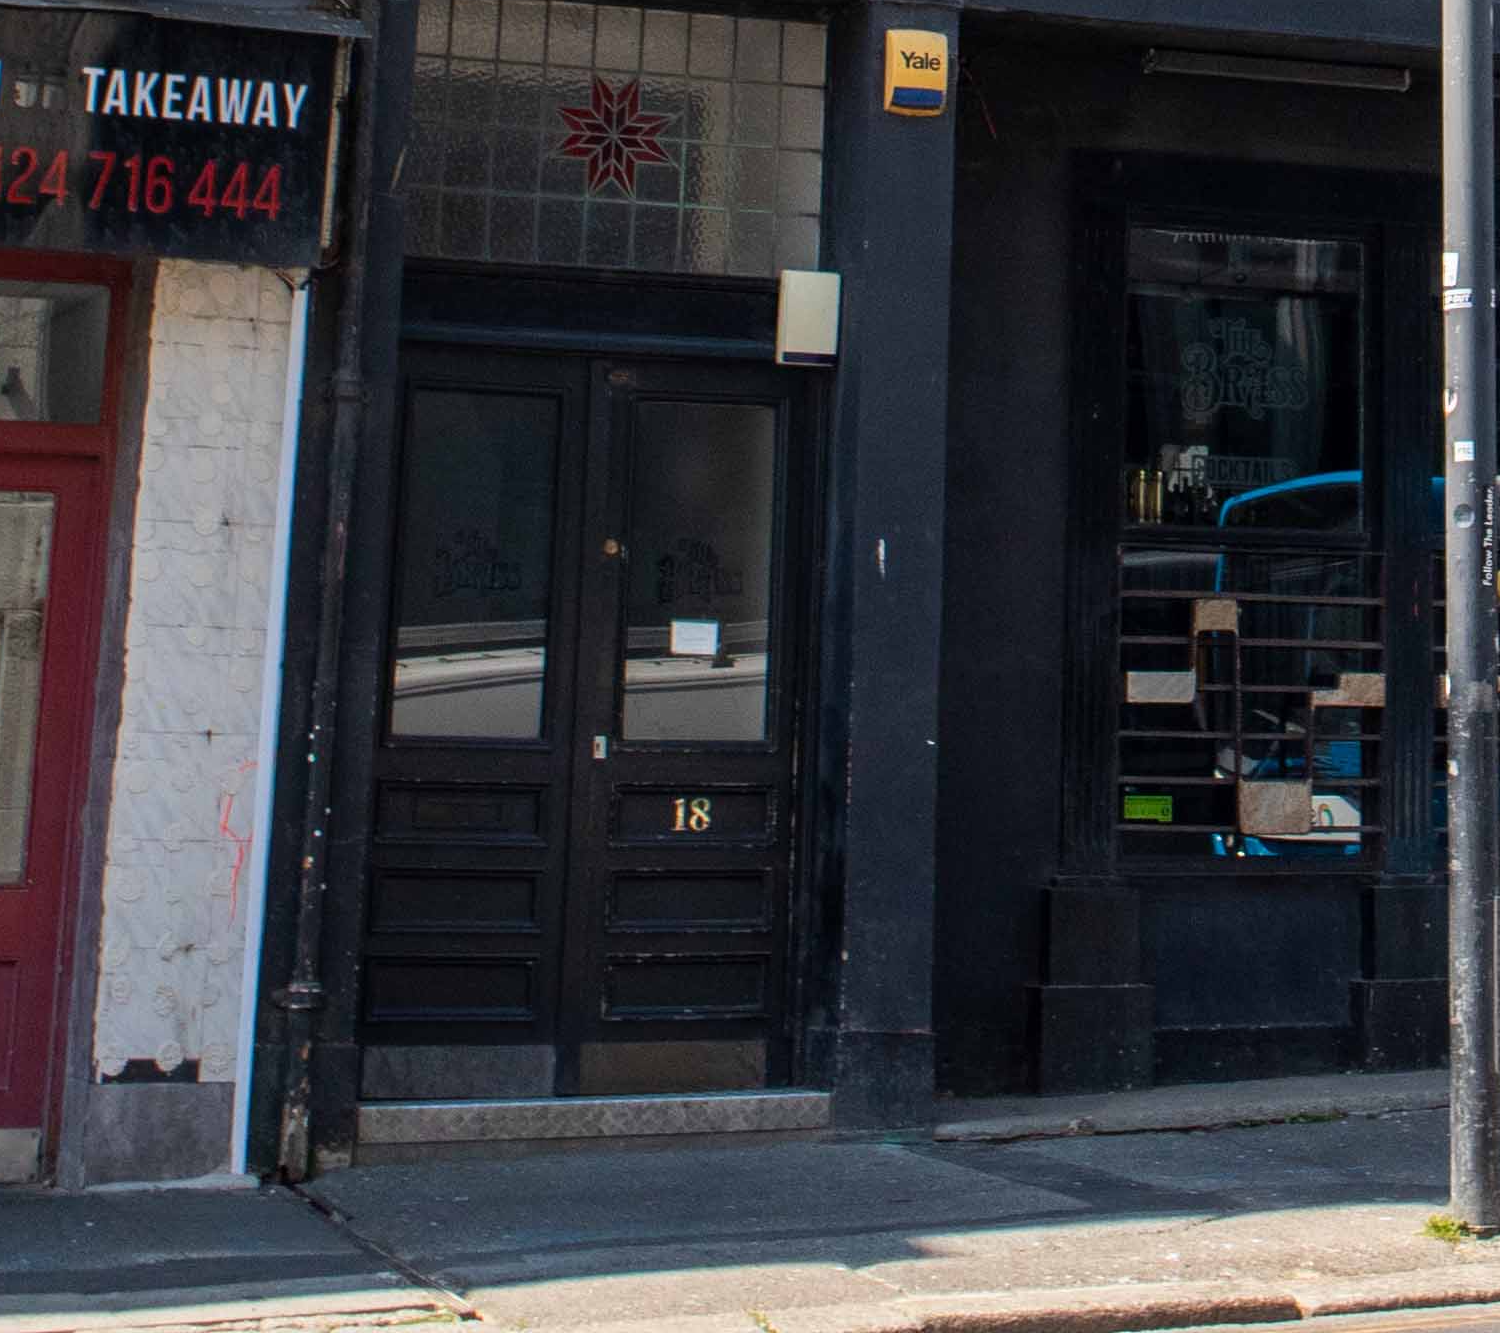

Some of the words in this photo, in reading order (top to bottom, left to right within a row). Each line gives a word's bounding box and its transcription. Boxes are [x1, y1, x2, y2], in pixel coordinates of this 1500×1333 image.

[900, 51, 941, 73] Yale
[82, 66, 309, 130] TAKEAWAY
[88, 150, 175, 214] 716
[187, 159, 283, 220] 444
[1482, 528, 1494, 548] The
[1481, 549, 1493, 587] Follow
[670, 797, 712, 834] 18
